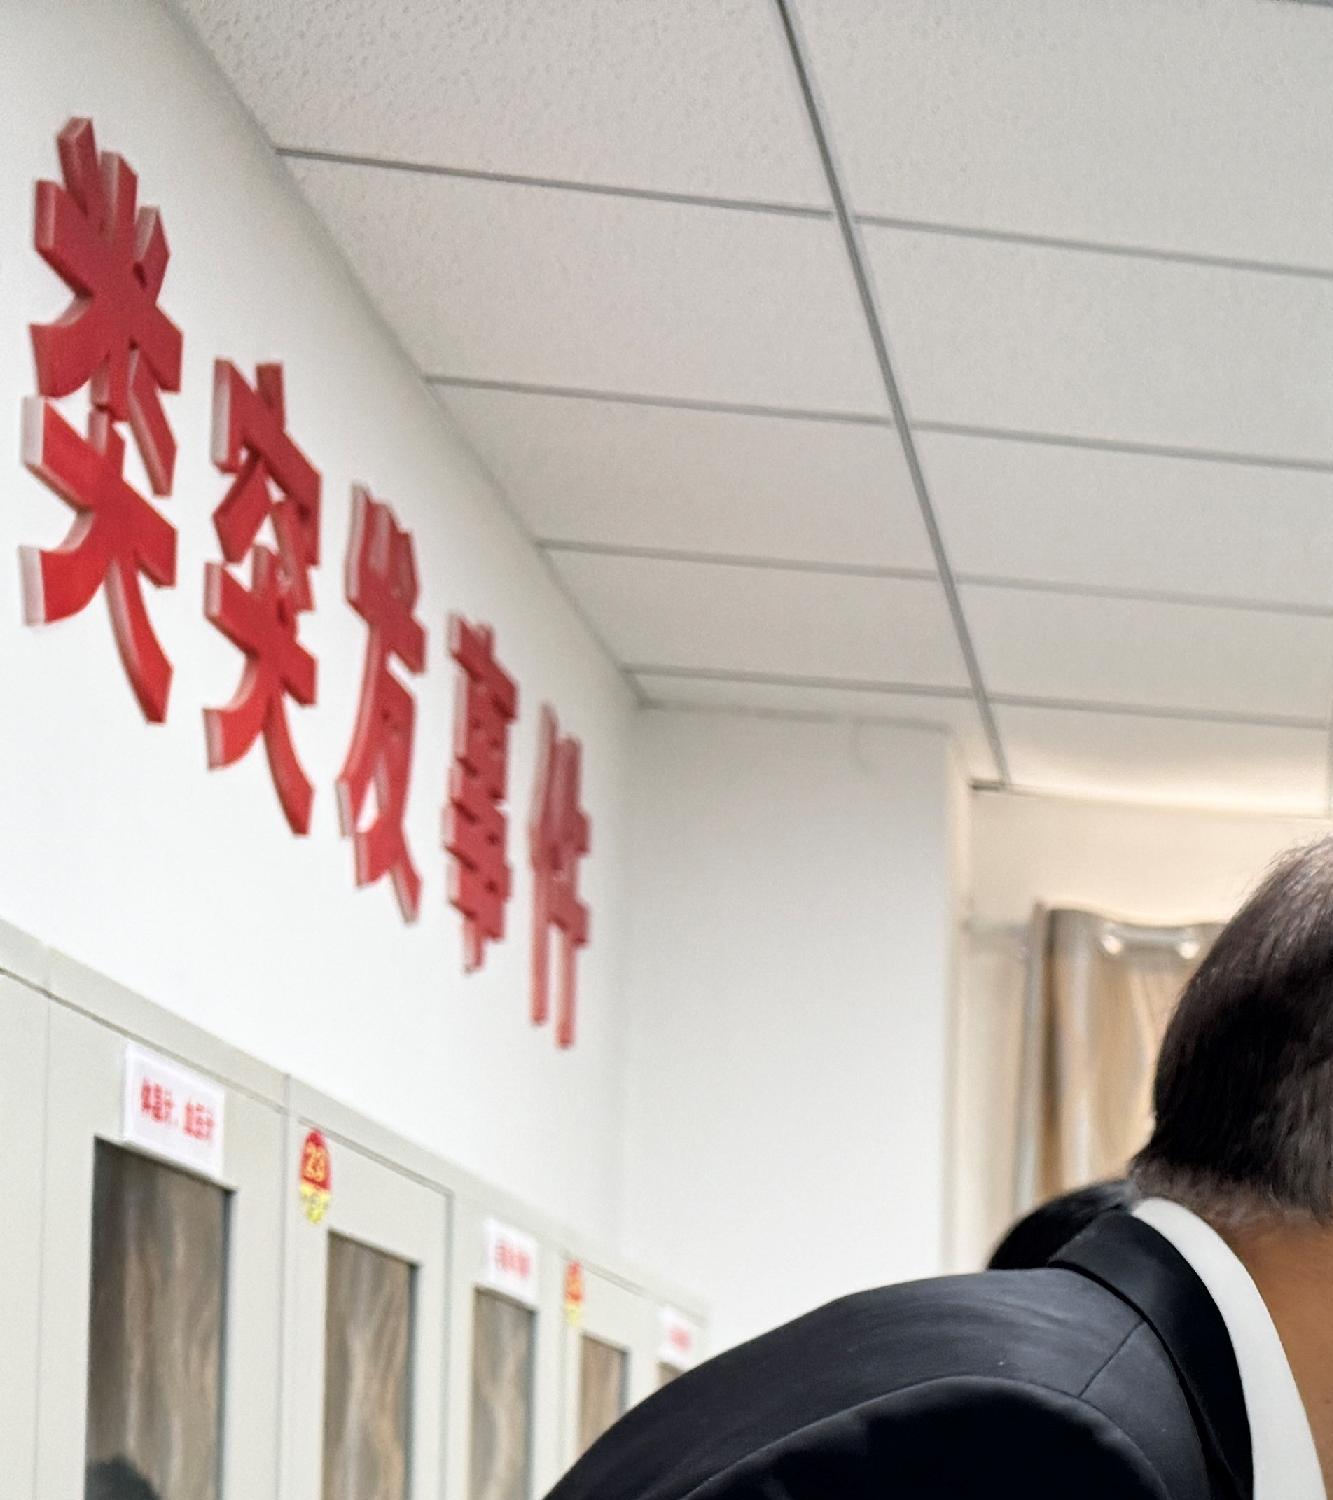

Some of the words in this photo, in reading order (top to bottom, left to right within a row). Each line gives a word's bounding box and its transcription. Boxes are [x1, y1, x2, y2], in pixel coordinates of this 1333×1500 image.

[20, 116, 589, 1051] 类突发事件
